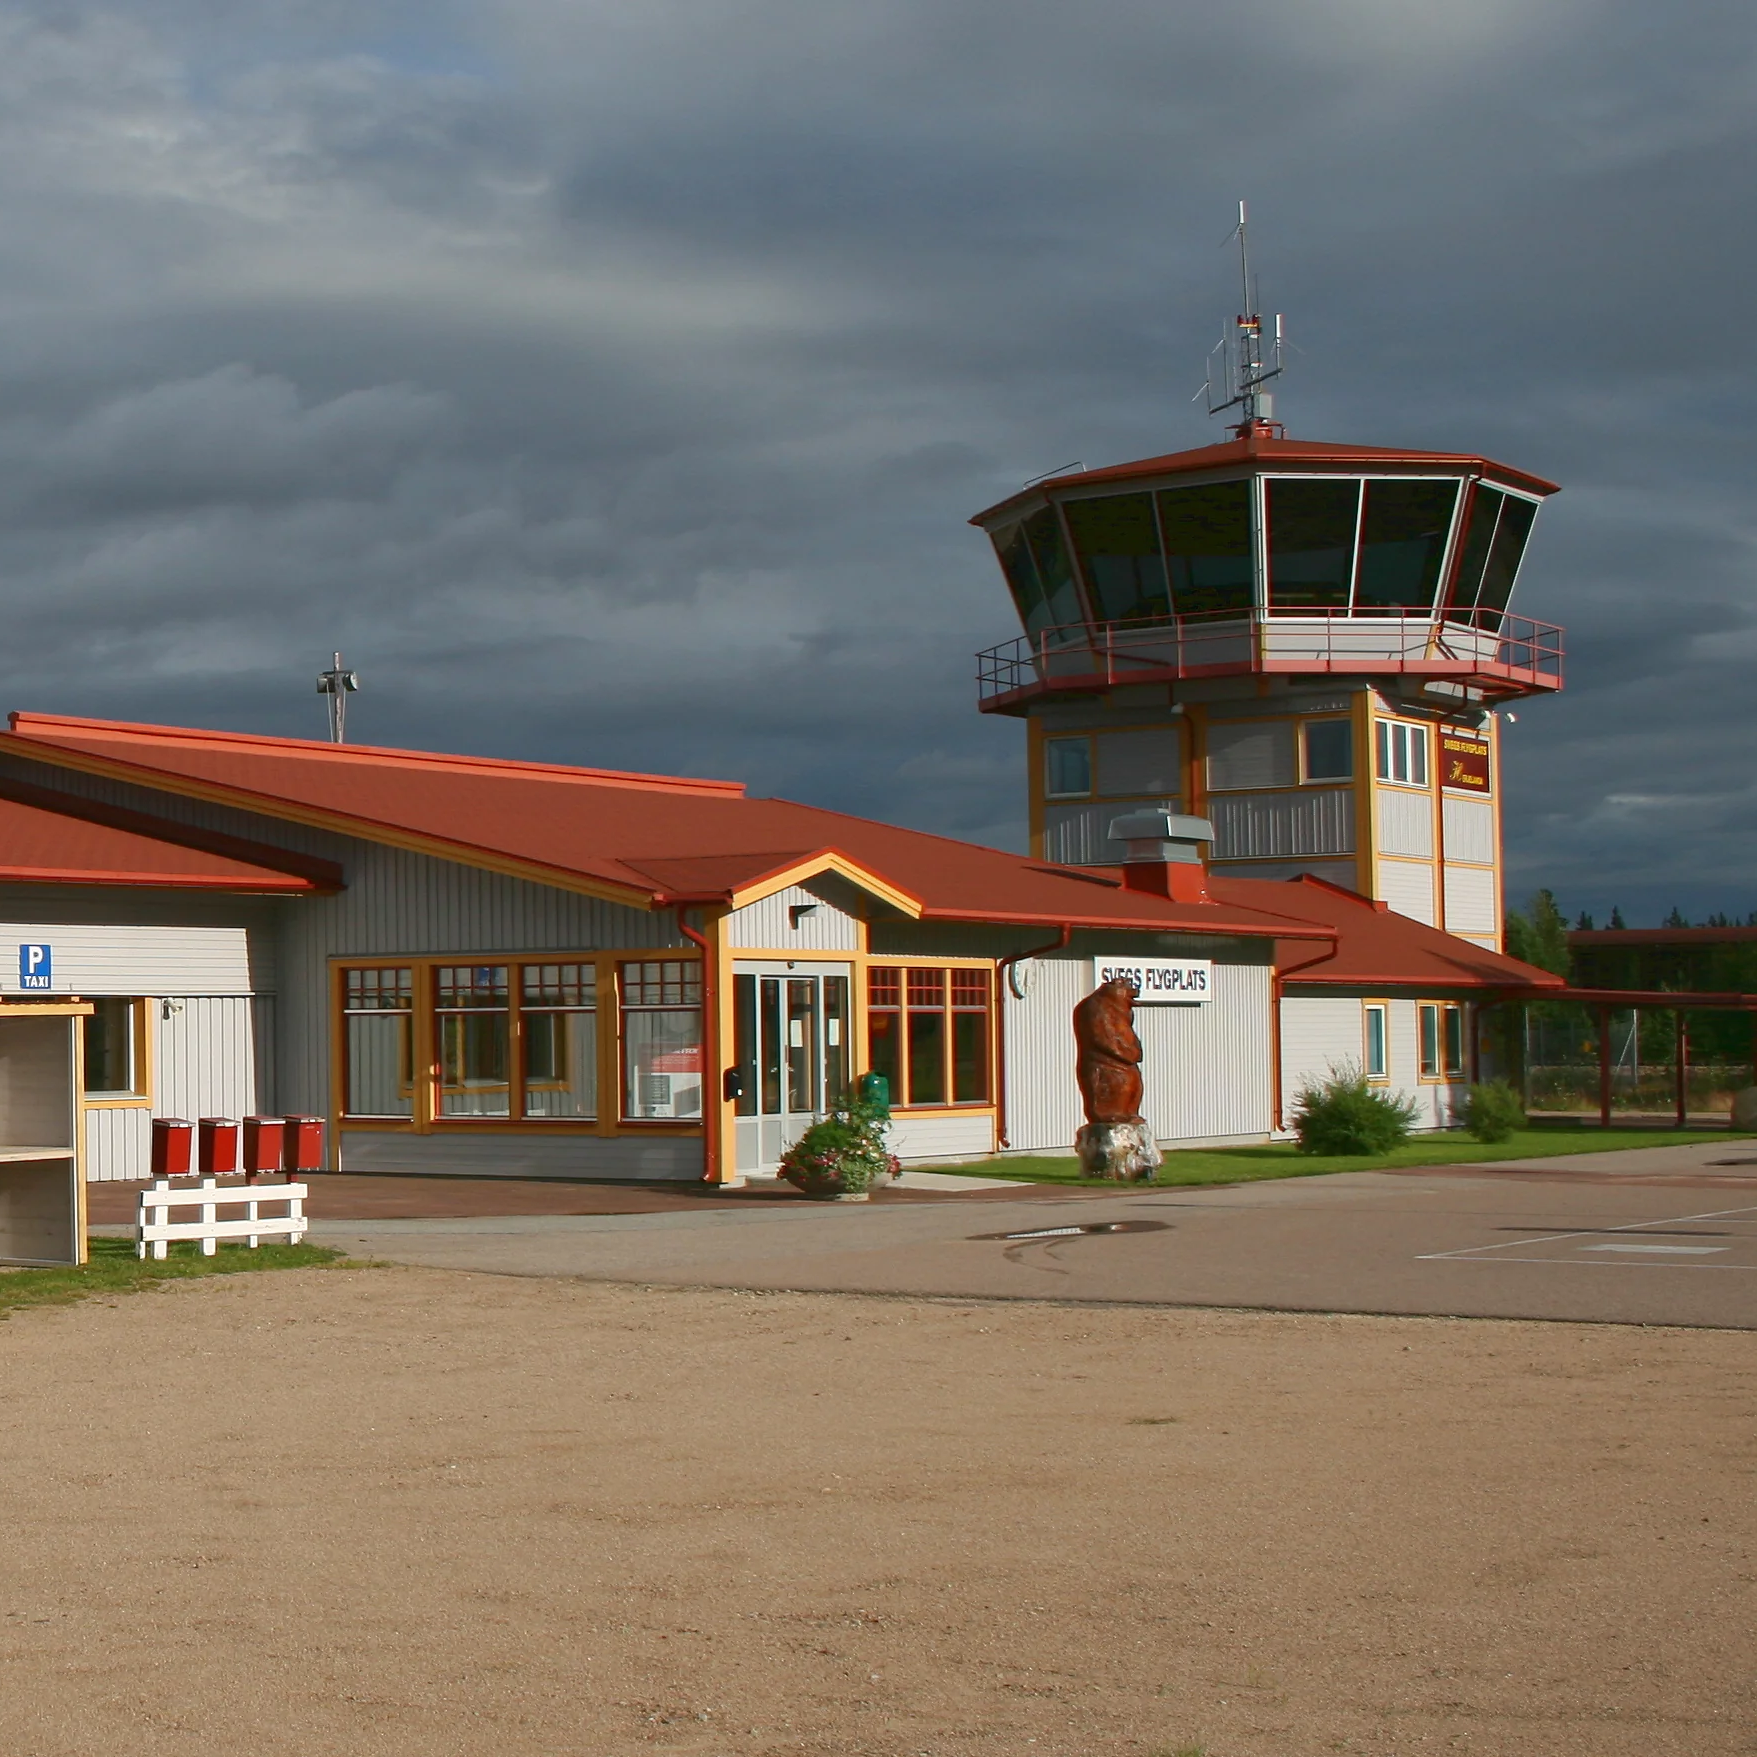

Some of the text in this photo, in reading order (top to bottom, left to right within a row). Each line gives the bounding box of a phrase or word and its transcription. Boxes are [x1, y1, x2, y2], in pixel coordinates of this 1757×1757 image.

[29, 946, 43, 974] P
[24, 975, 49, 988] TAXI
[1145, 968, 1206, 990] FLYGPLATS
